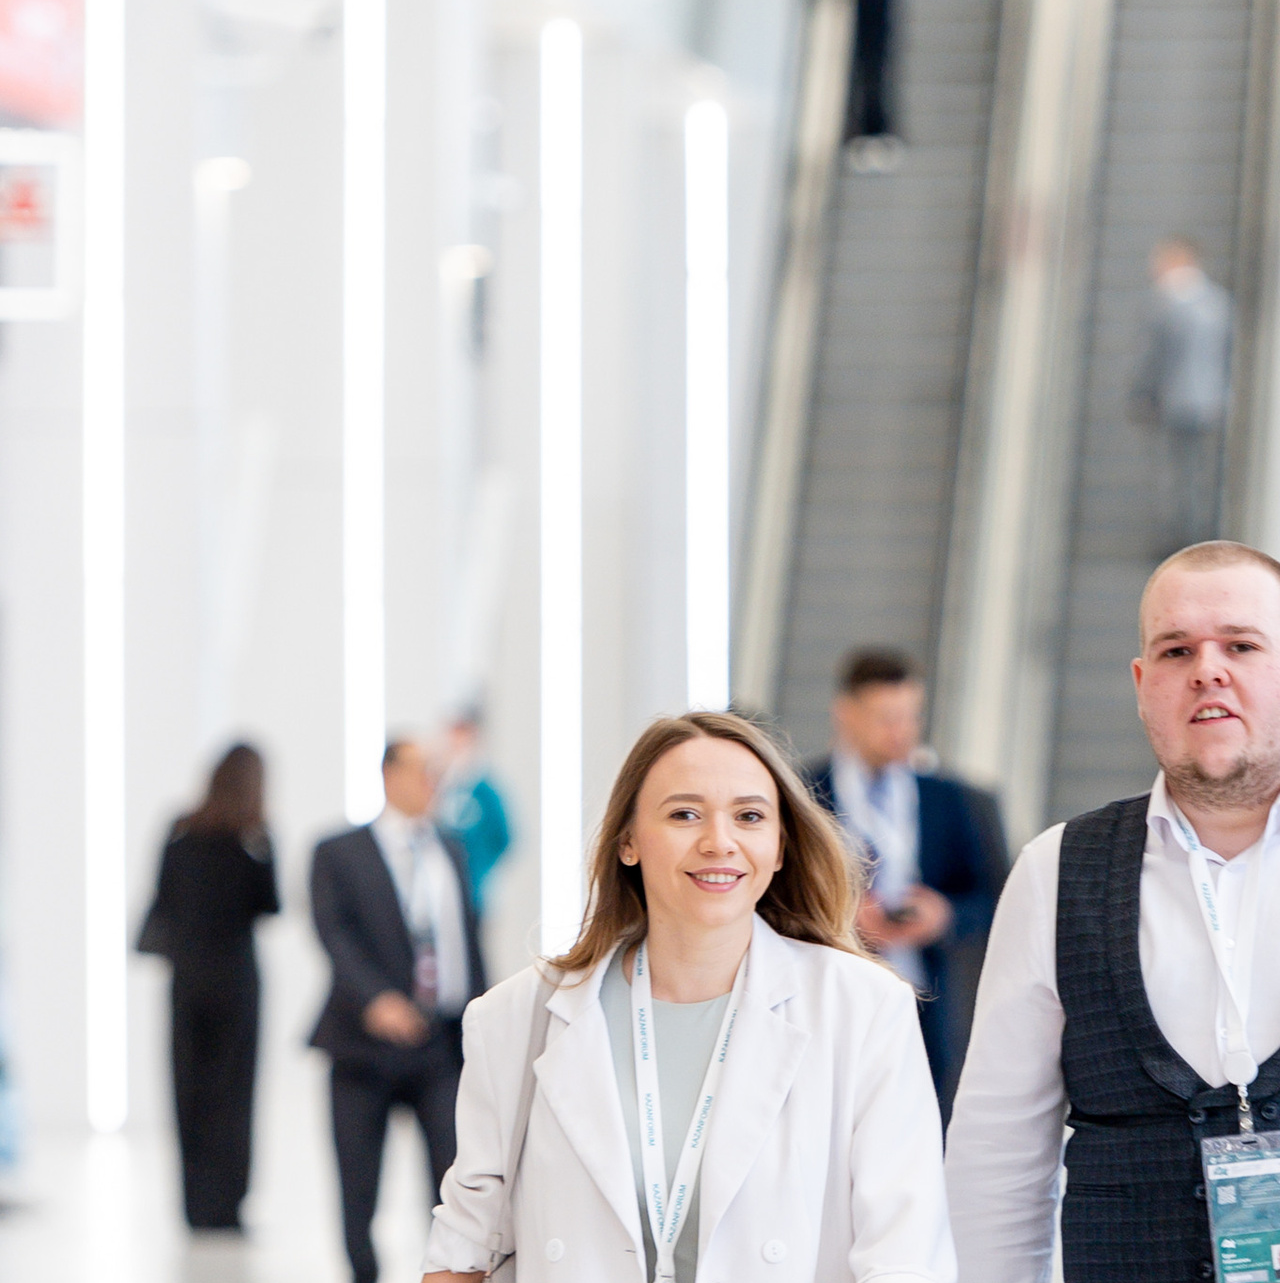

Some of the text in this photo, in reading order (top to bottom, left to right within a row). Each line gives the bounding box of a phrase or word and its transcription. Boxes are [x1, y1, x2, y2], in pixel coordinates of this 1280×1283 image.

[638, 1008, 649, 1060] KAZANFORUM
[645, 1093, 655, 1147] KAZANFORUM
[691, 1095, 713, 1148] KAZANFORUM
[667, 1184, 686, 1243] KAZANFORUM
